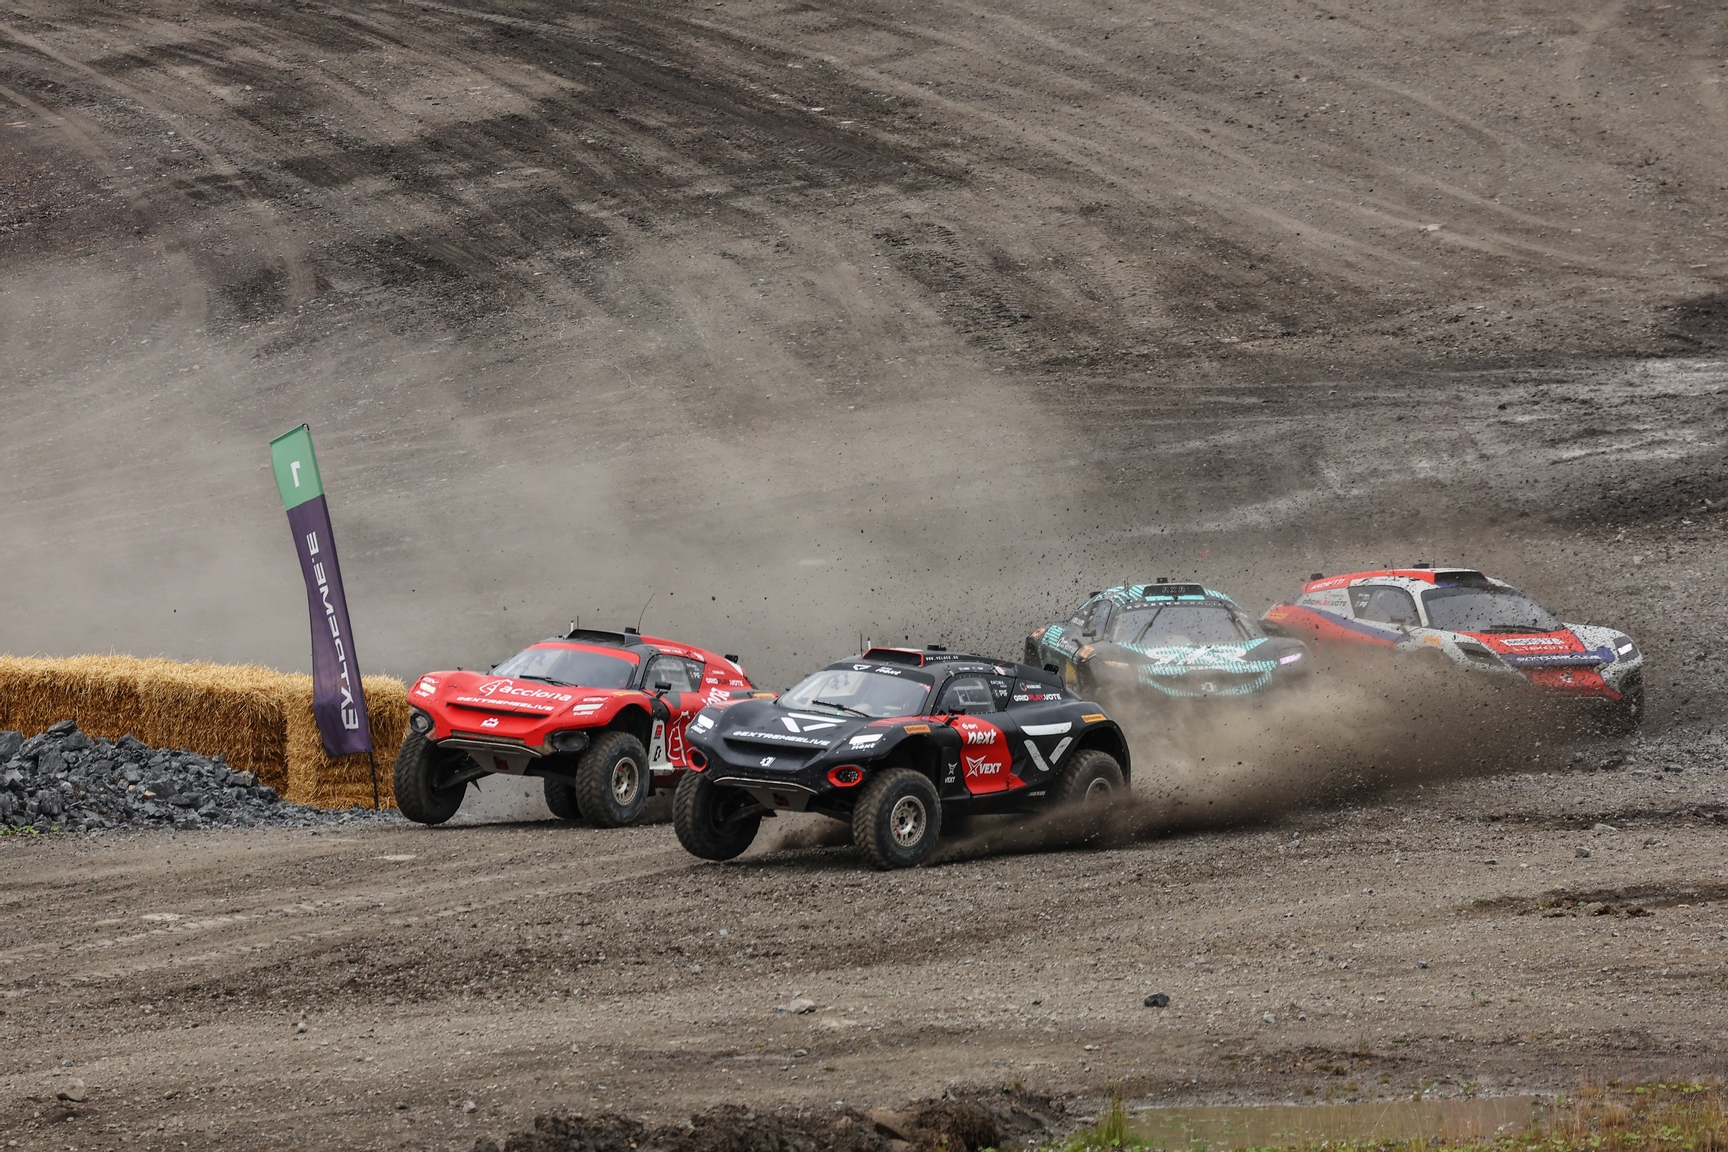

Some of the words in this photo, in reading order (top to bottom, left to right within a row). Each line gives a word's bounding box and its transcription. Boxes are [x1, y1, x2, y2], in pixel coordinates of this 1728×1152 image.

[1309, 578, 1346, 591] ANDRETTI
[498, 685, 573, 702] acciona
[1013, 693, 1062, 702] GRIDPLAY.VOTE
[456, 696, 555, 711] @EXTREMEELIVE
[732, 731, 831, 746] @EXTREMEELIVE
[967, 728, 997, 745] next
[979, 762, 1002, 775] VEXT
